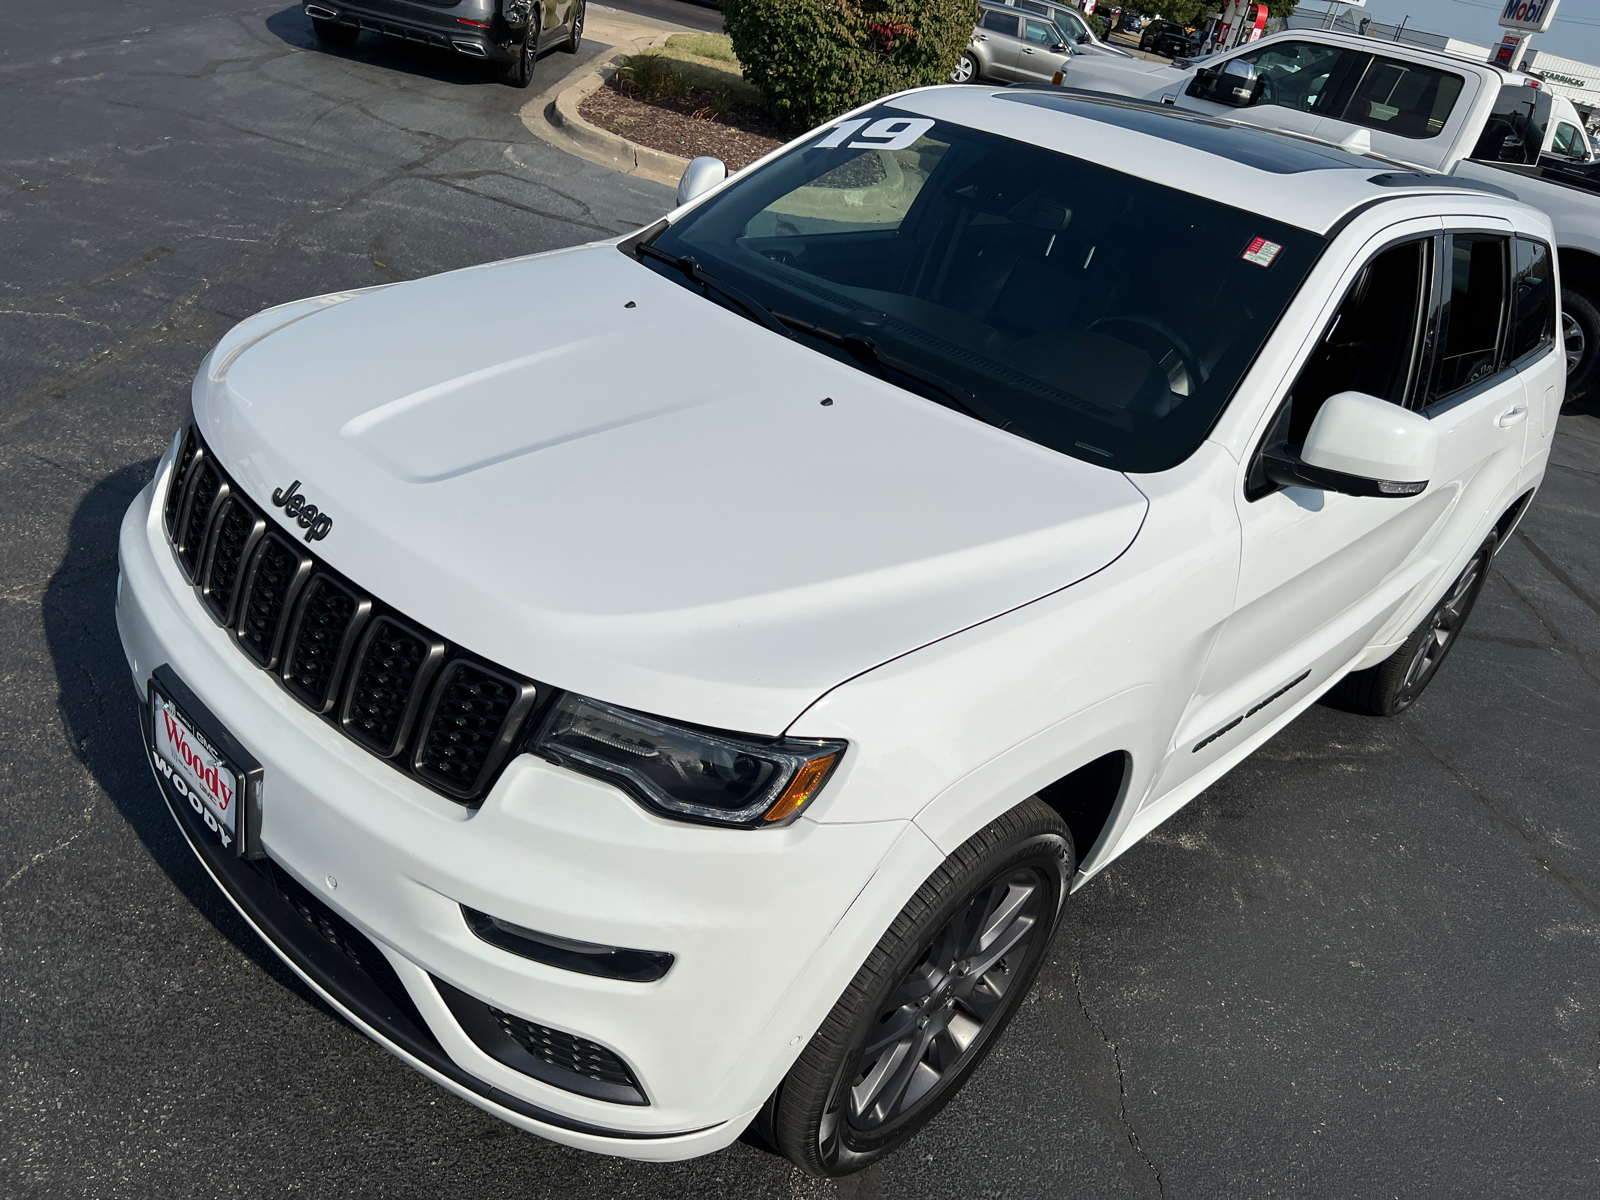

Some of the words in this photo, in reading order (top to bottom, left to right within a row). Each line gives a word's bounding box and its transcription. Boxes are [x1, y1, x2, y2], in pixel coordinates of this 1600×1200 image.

[1503, 0, 1547, 23] Mobil
[1539, 71, 1585, 87] STARBUCKS
[813, 117, 936, 150] 19
[272, 480, 333, 543] Jeep
[163, 709, 233, 811] Woody
[196, 731, 219, 761] GMC
[153, 751, 232, 849] WOODY
